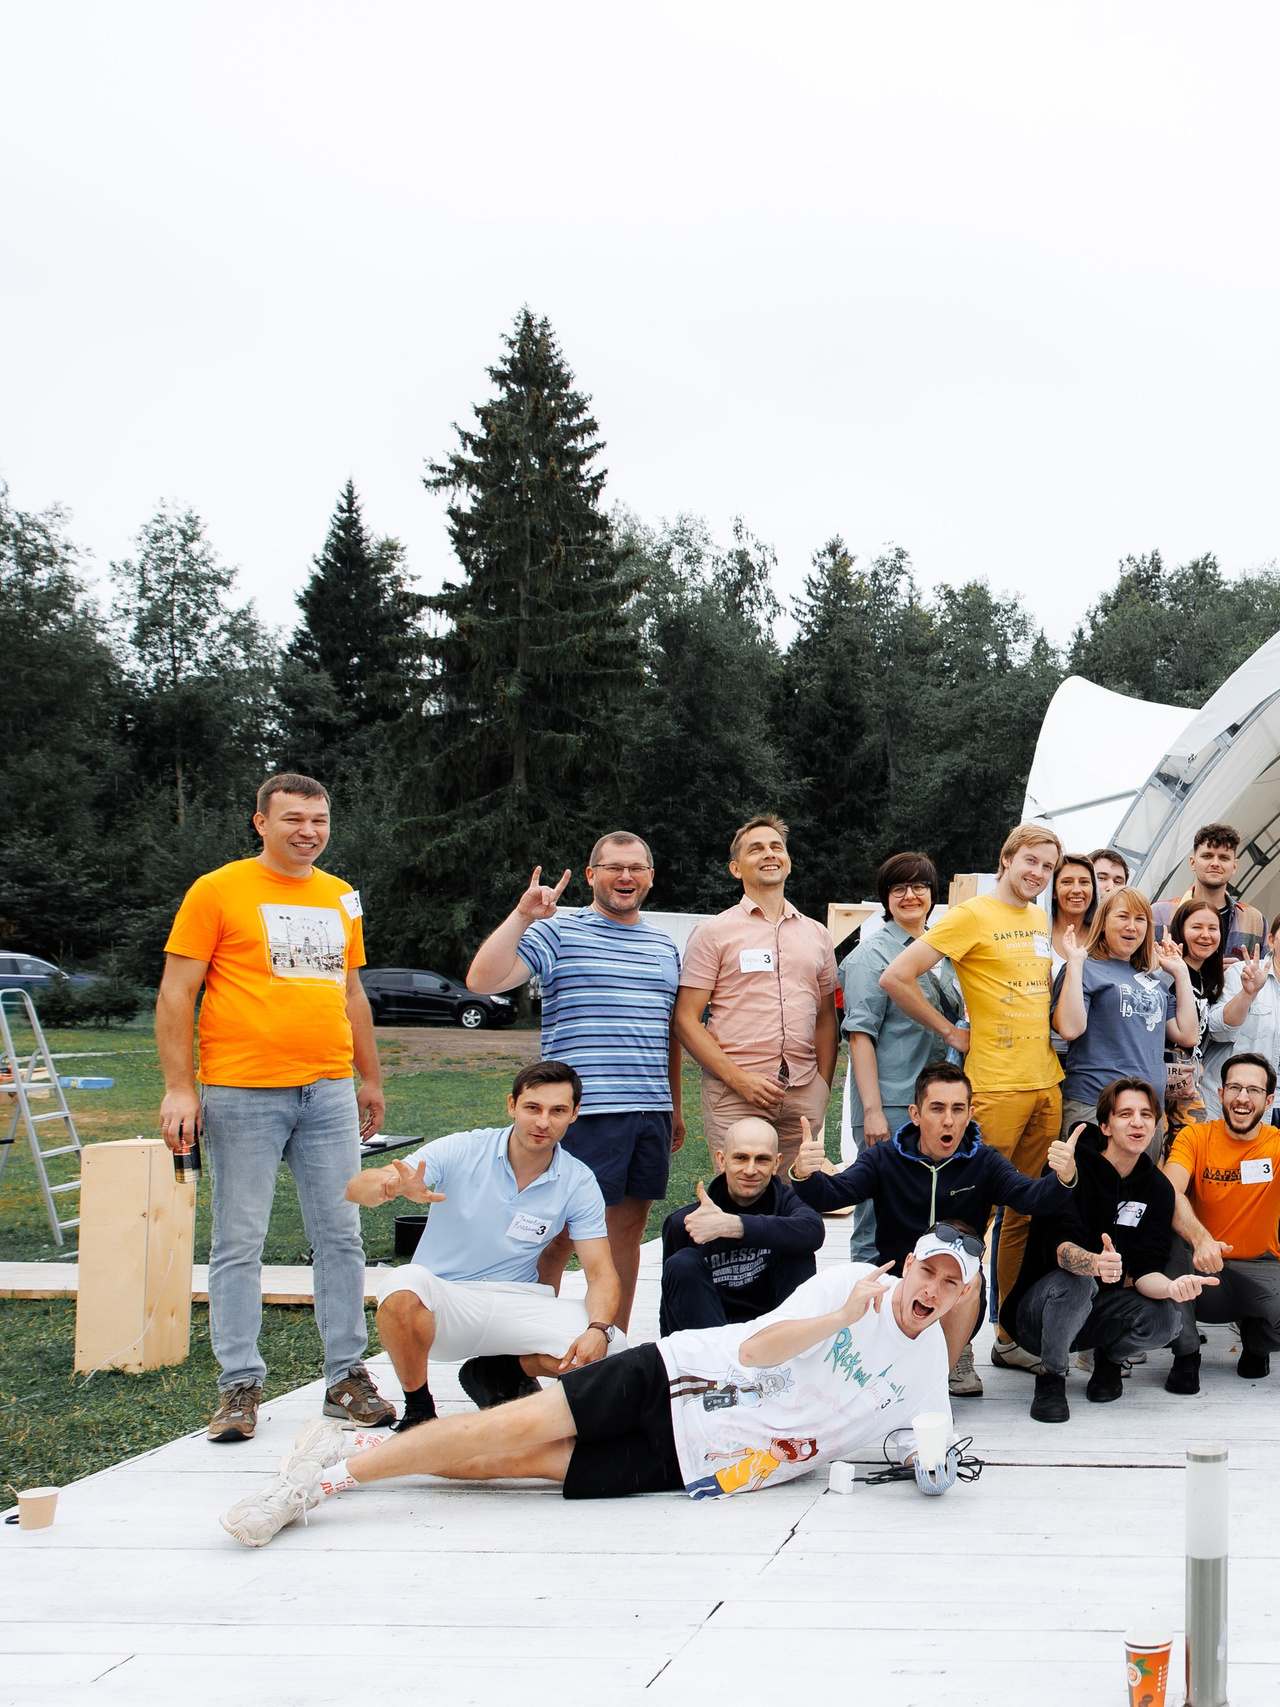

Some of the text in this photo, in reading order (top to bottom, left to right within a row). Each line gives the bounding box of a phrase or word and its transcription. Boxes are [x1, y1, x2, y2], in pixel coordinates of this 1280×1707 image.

[994, 931, 1012, 941] SAN
[763, 954, 772, 964] 3
[1167, 1067, 1183, 1076] IRL
[1263, 1164, 1271, 1174] 3
[1136, 1208, 1143, 1218] 3
[536, 1225, 547, 1235] 3
[881, 1398, 891, 1409] 3
